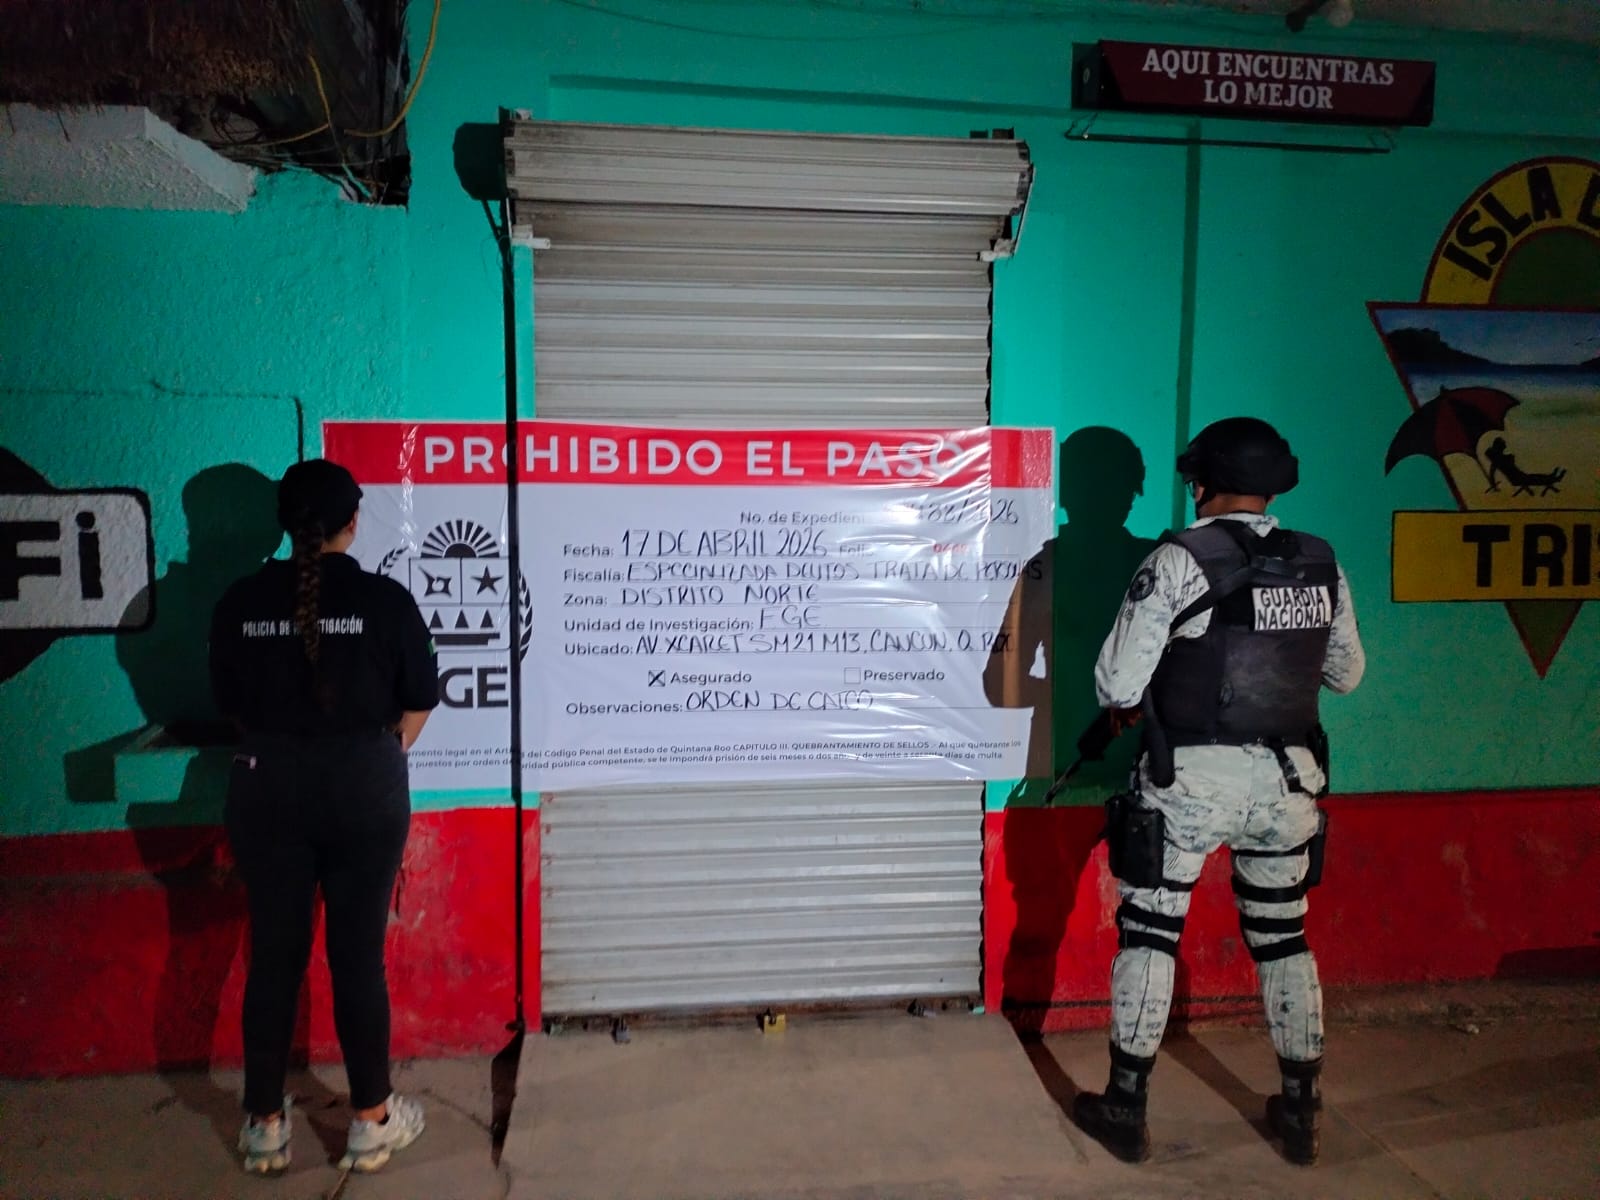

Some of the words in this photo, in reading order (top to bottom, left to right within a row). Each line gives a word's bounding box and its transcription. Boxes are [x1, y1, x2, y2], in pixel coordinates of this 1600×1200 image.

[1142, 48, 1210, 79] AQUI
[1217, 52, 1394, 85] ENCUENTRAS
[1204, 79, 1238, 104] LO
[1245, 82, 1334, 109] MEJOR
[1442, 165, 1562, 282] ISLA
[424, 435, 723, 475] PRHIBIDO
[746, 440, 804, 476] EL
[827, 441, 963, 478] PASO
[740, 512, 764, 524] No.
[768, 512, 788, 523] de
[563, 543, 614, 557] Fecha:
[621, 529, 650, 557] 17
[657, 529, 692, 557] DE
[697, 528, 769, 557] ABRIL
[777, 527, 827, 557] 2026
[1463, 523, 1600, 588] TRI
[563, 568, 625, 582] Fiscalía:
[872, 560, 938, 580] TRATA
[563, 593, 608, 606] Zona:
[622, 585, 724, 607] DISTRITO
[744, 583, 819, 605] NORTE
[1260, 587, 1325, 609] GUARDIA
[565, 618, 621, 632] Unidad
[626, 618, 645, 631] de
[650, 617, 755, 633] Investigación:
[1257, 607, 1330, 630] NACIONAL
[565, 642, 634, 656] Ubicado:
[665, 634, 744, 653] XCARET
[670, 671, 752, 685] Asegurado
[864, 669, 945, 682] Preservado
[437, 667, 509, 709] GE
[566, 702, 683, 715] Observaciones:
[686, 690, 761, 711] ORDEN
[580, 747, 604, 756] Penal
[624, 745, 654, 754] Estado
[657, 744, 668, 753] de
[671, 743, 711, 754] Quintana
[714, 743, 731, 752] Roo
